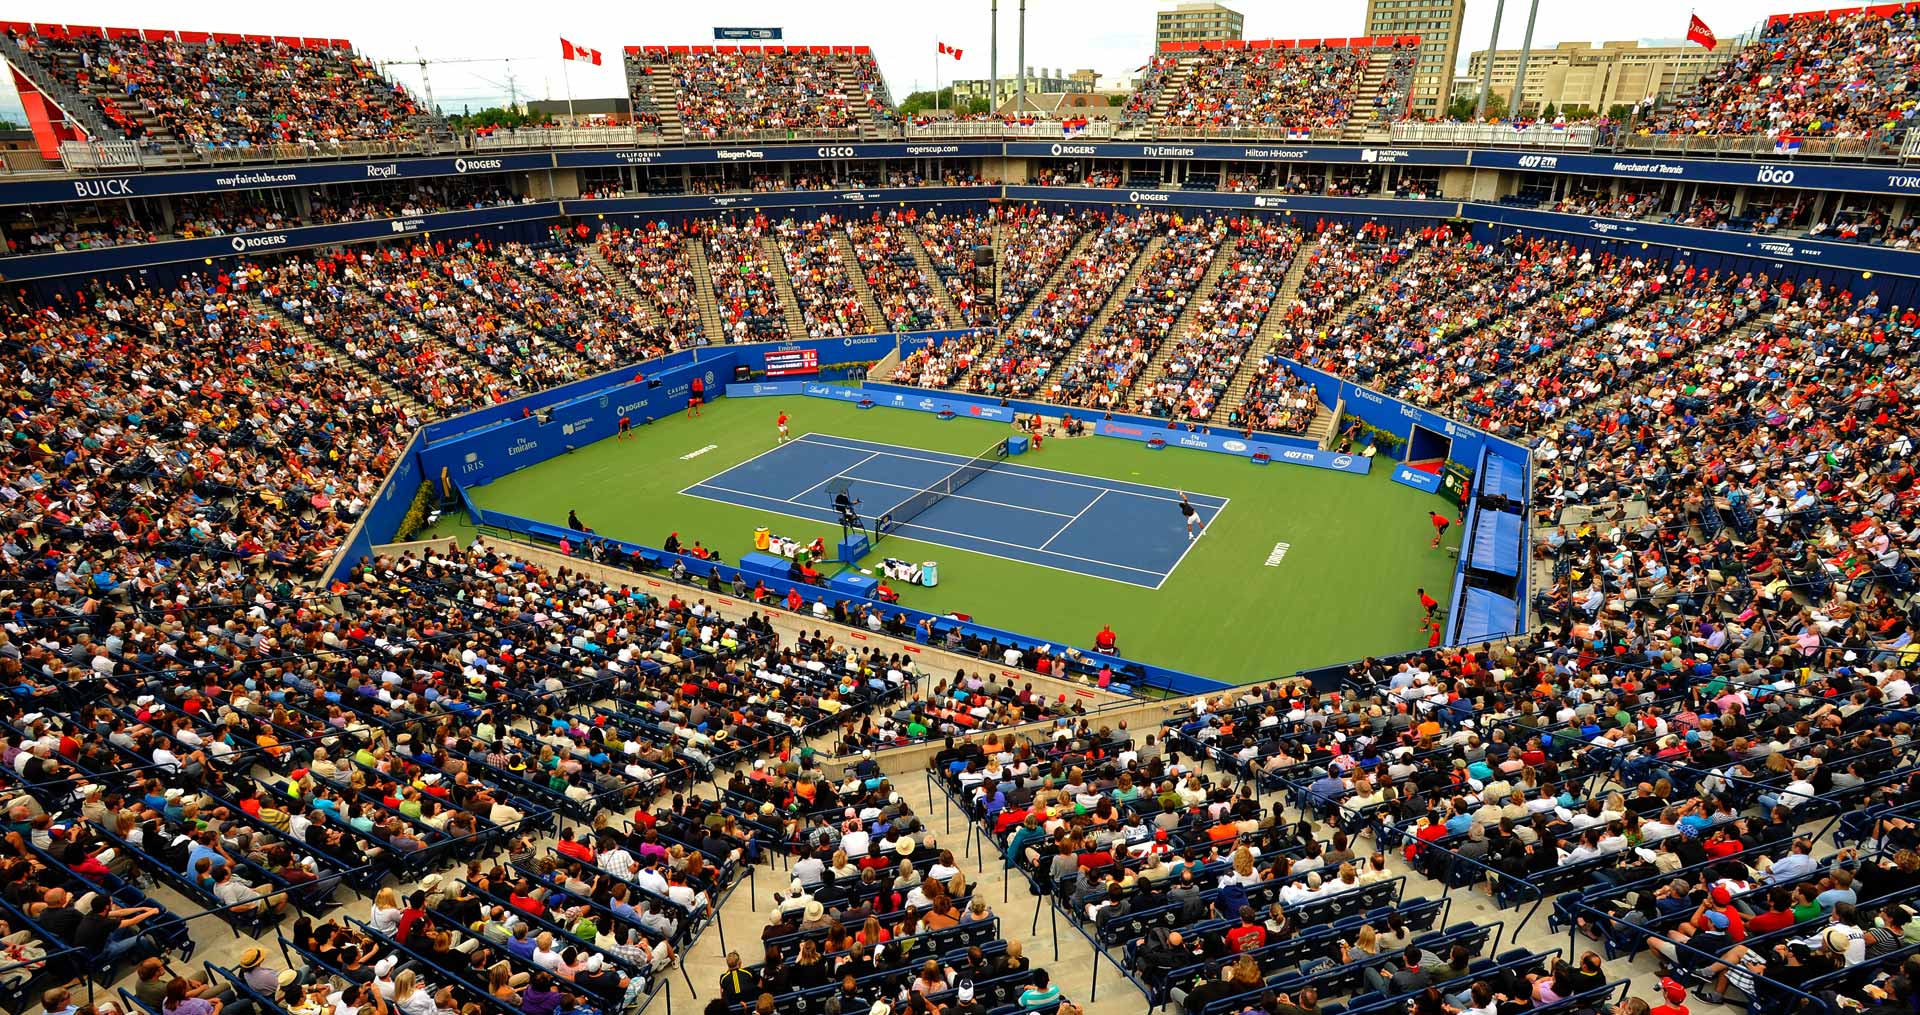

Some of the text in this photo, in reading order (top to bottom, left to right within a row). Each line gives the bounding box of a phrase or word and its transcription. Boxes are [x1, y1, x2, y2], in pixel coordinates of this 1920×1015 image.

[717, 149, 764, 160] Häagen-Dazs
[818, 147, 853, 158] CISCO
[907, 145, 959, 154] rogerscup.com
[1062, 146, 1095, 155] ROGERS
[1144, 146, 1194, 157] Fly Emirates
[1245, 148, 1268, 158] Hilton
[1379, 150, 1409, 158] NATIONAL
[468, 160, 501, 170] ROGERS
[1518, 155, 1557, 167] 407 ETR
[367, 164, 397, 178] Rexall
[1614, 162, 1684, 174] Merchant of Tennis
[217, 173, 297, 187] mayfairclubs.com
[75, 179, 134, 197] BUICK
[1140, 193, 1169, 201] ROGERS
[246, 235, 286, 248] ROGERS
[852, 337, 877, 345] ROGERS
[667, 384, 689, 395] CASINO
[1362, 393, 1383, 405] ROGERS
[625, 400, 649, 412] ROGERS
[1400, 405, 1423, 422] FedEx
[508, 441, 537, 456] Emirates
[1180, 438, 1208, 448] Emirates
[1283, 450, 1302, 459] 407
[462, 461, 485, 474] IRIS
[1264, 541, 1291, 567] TORONTO
